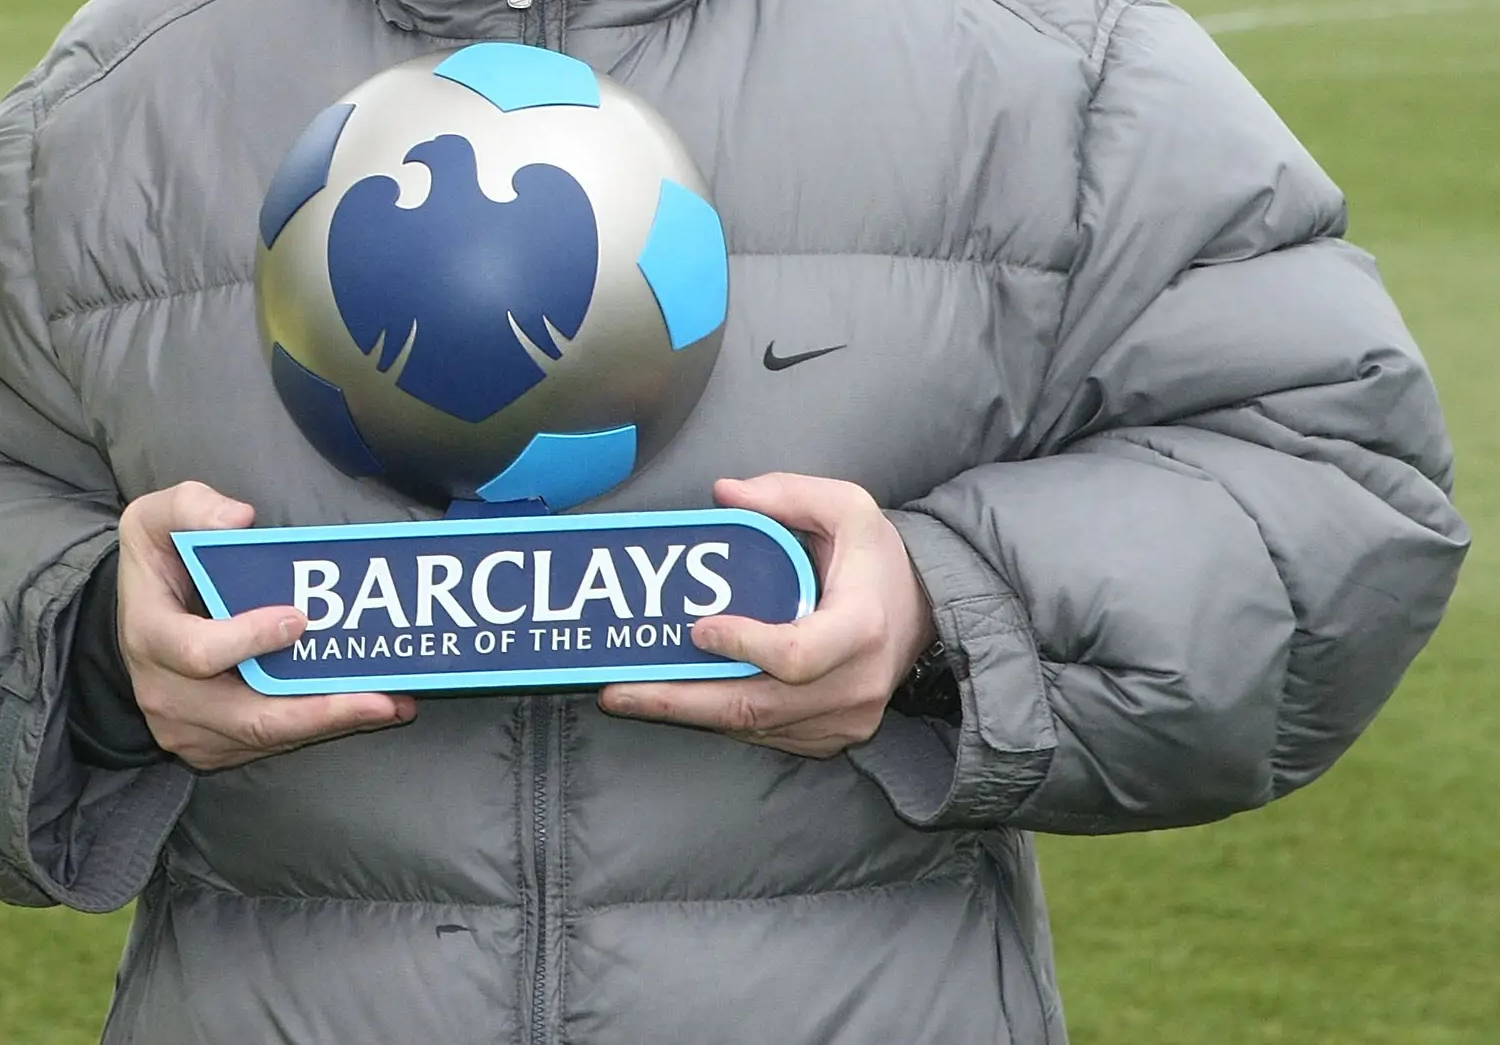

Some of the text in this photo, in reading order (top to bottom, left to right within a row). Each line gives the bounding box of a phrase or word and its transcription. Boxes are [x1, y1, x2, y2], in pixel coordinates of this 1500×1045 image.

[292, 542, 732, 631] BARCLAYS
[292, 622, 696, 662] MANAGER OF THE MON
